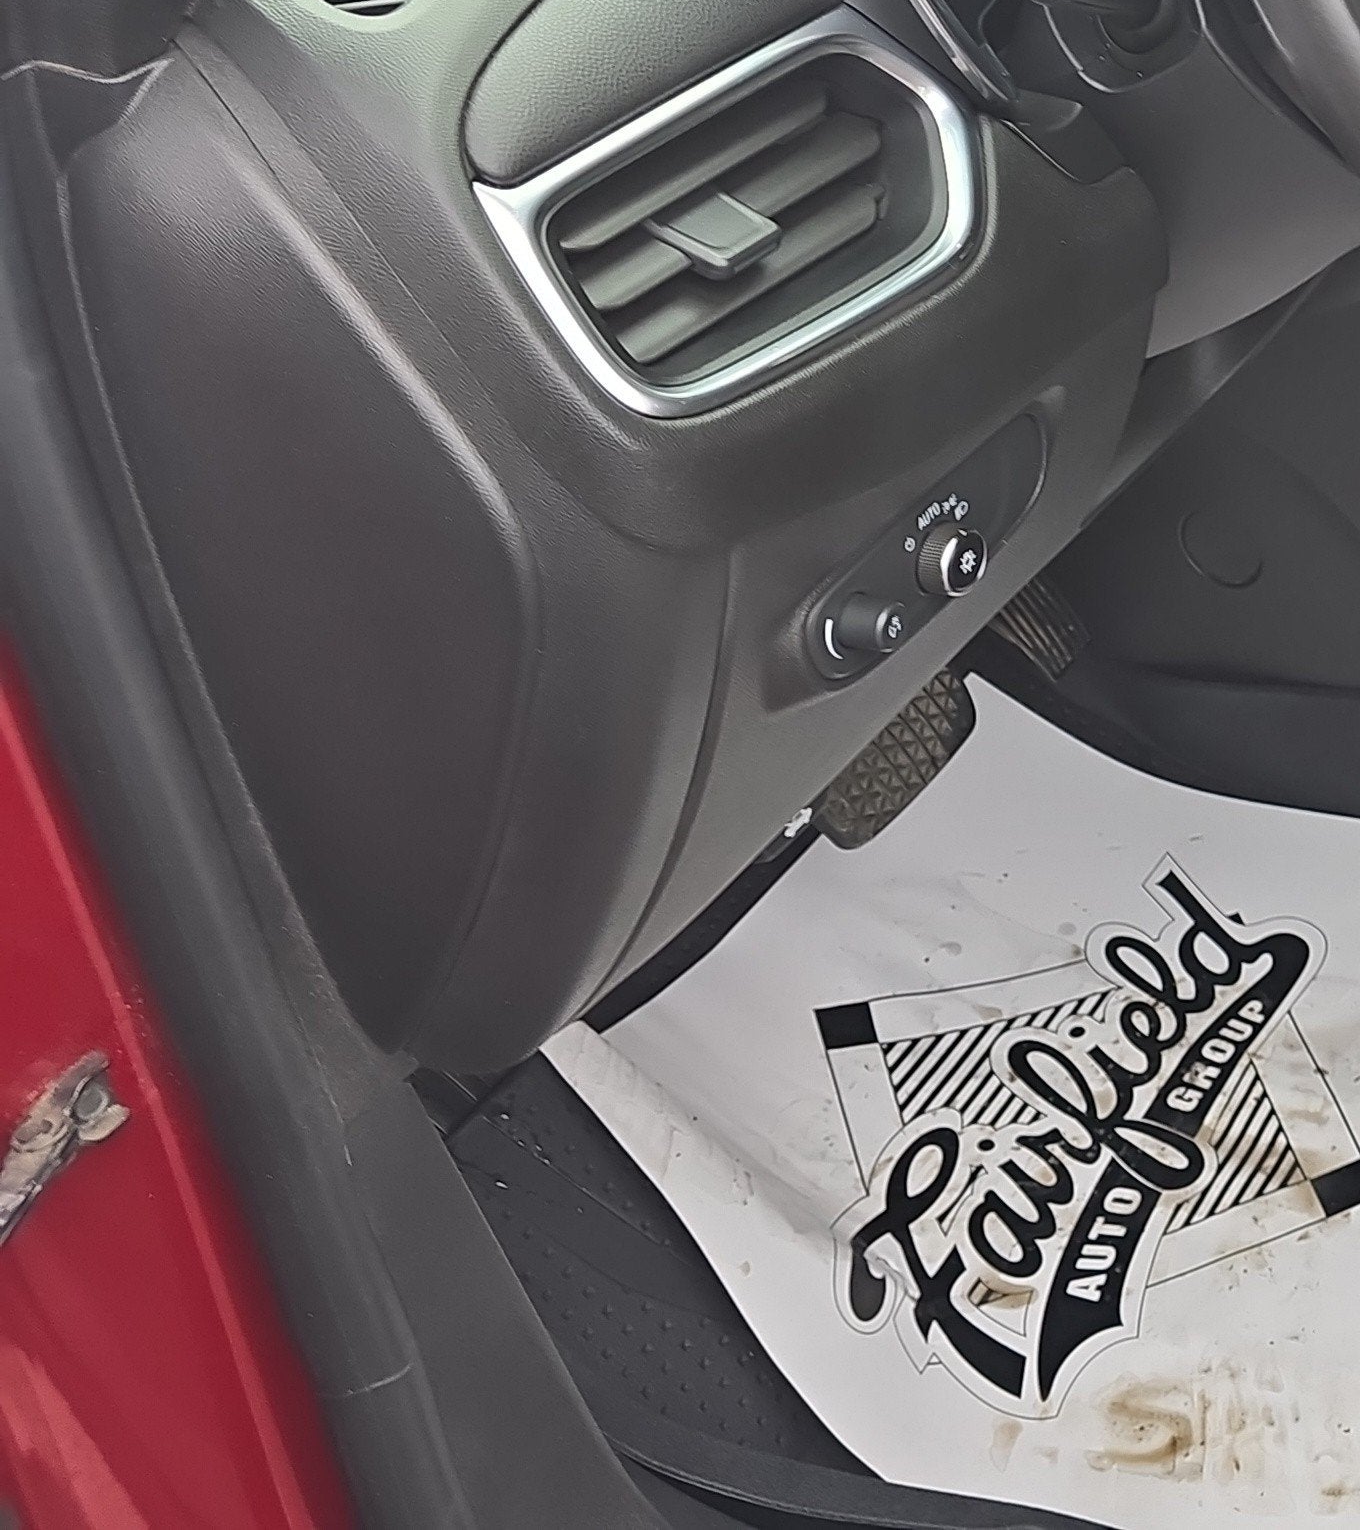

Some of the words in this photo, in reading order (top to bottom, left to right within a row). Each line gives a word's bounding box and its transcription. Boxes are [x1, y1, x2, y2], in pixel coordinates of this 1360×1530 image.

[917, 501, 941, 531] AUTO
[851, 870, 1309, 1401] Fairfield
[1065, 1186, 1144, 1302] AUTO
[1165, 998, 1269, 1113] GROUP
